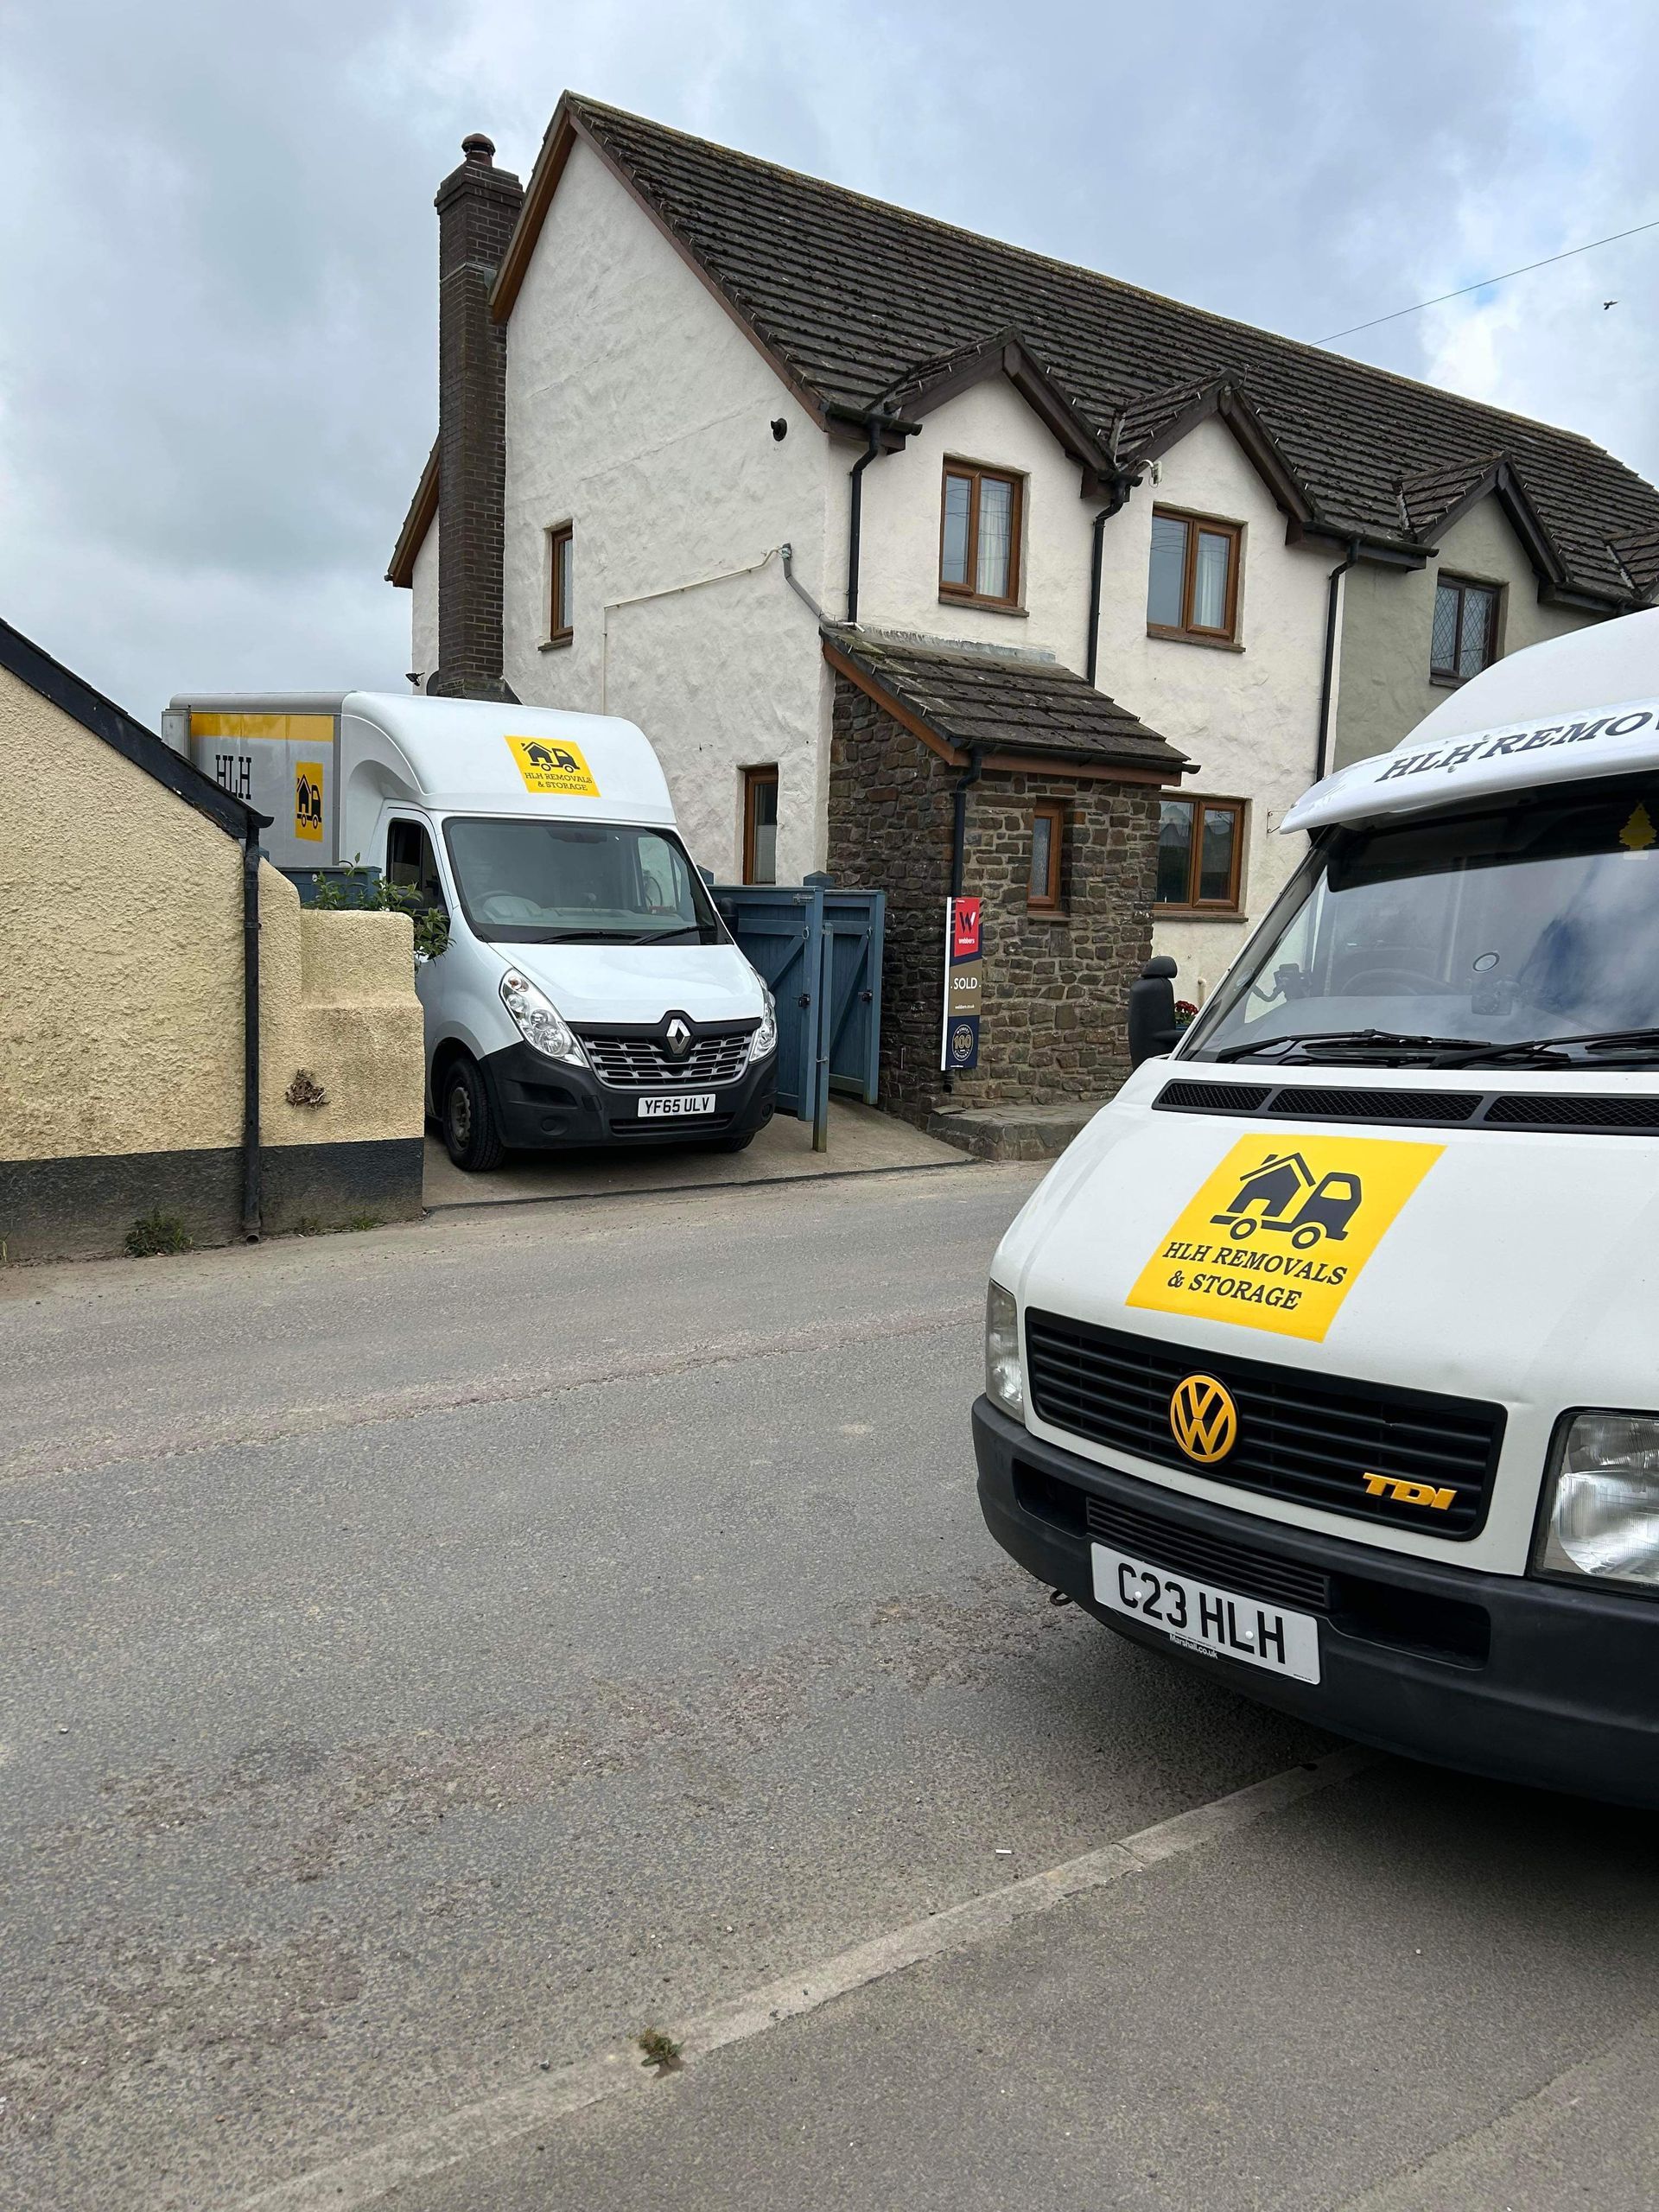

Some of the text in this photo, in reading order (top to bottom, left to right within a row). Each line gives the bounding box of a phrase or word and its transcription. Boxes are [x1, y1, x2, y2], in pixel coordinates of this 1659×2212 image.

[1374, 712, 1659, 783] HLH REMO
[215, 754, 251, 800] HLH
[544, 773, 593, 784] REMOVALS
[546, 782, 588, 791] STORAGE
[953, 977, 978, 990] SOLD
[954, 1034, 972, 1049] 100
[645, 1096, 710, 1115] YF65 ULV
[1162, 1242, 1348, 1286] HLH REMOVALS
[1167, 1270, 1303, 1310] & STORAGE
[1363, 1471, 1458, 1510] TDI
[1118, 1562, 1286, 1665] C23 HLH
